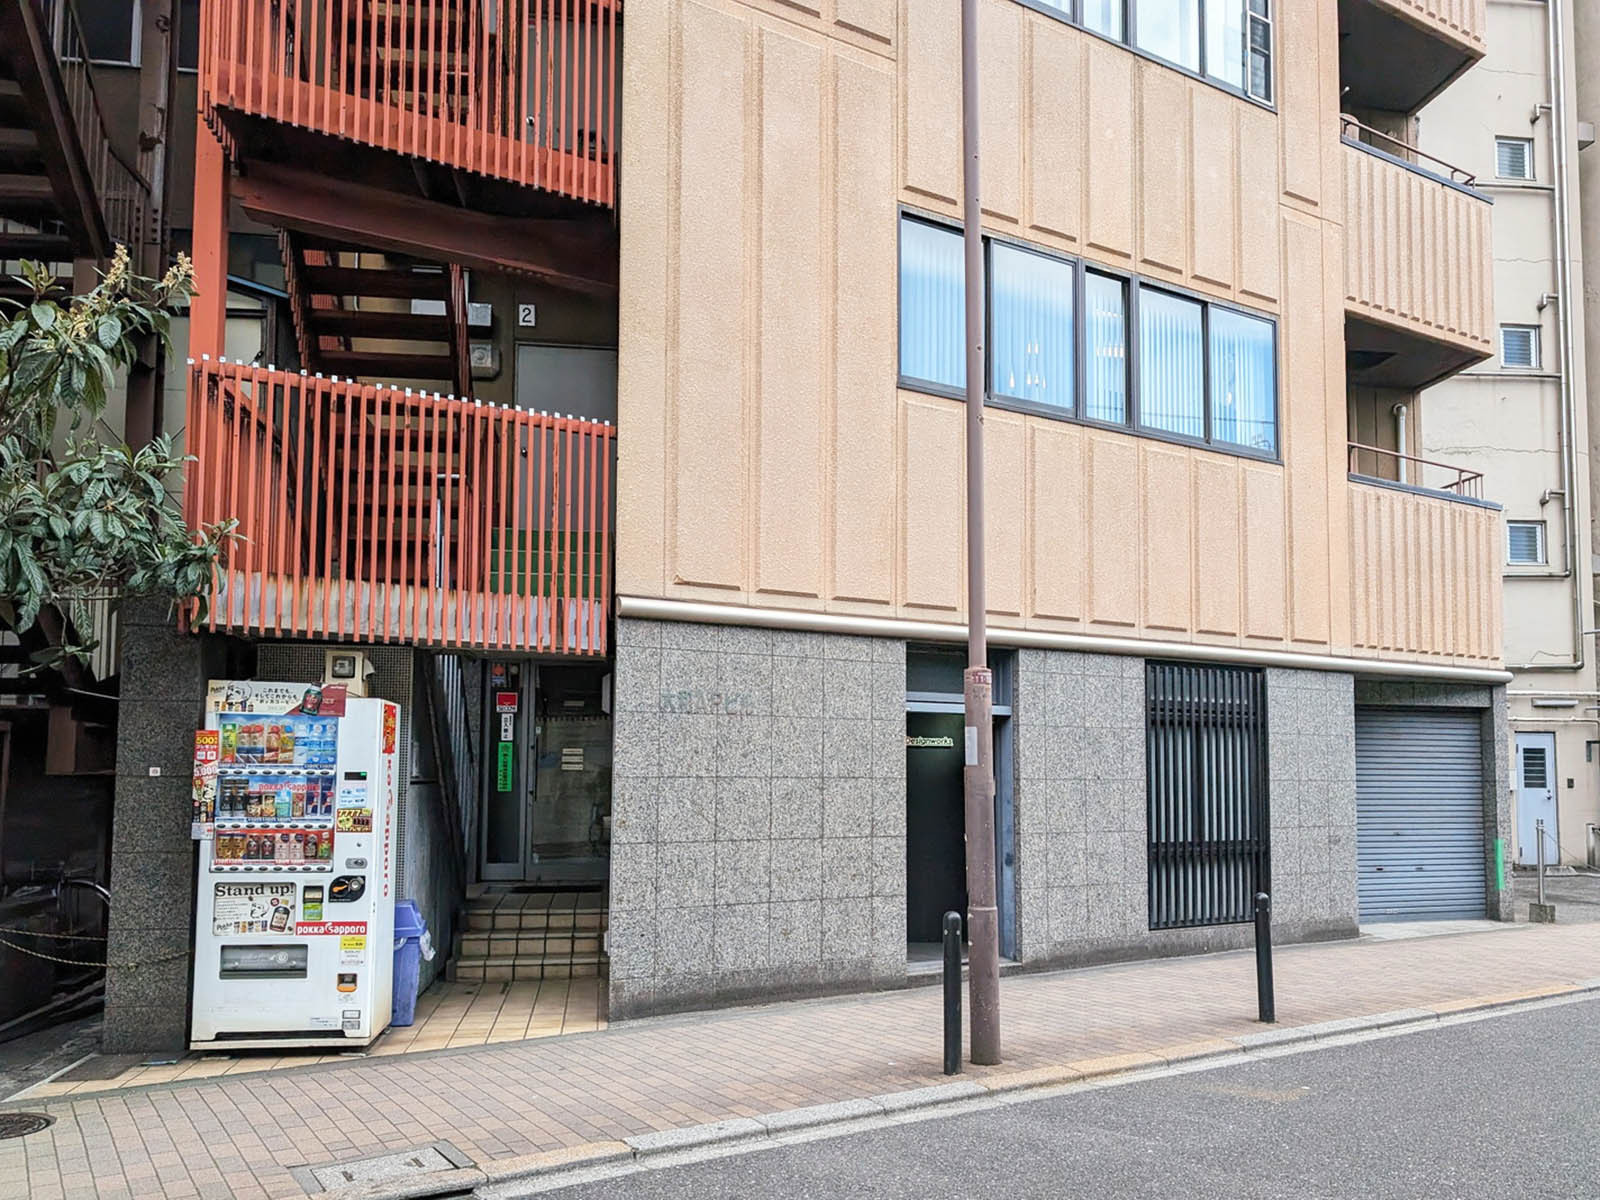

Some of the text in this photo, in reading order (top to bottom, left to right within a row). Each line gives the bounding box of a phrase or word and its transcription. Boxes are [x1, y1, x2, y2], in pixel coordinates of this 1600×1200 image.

[522, 307, 532, 323] 2
[215, 884, 294, 897] Stand up!
